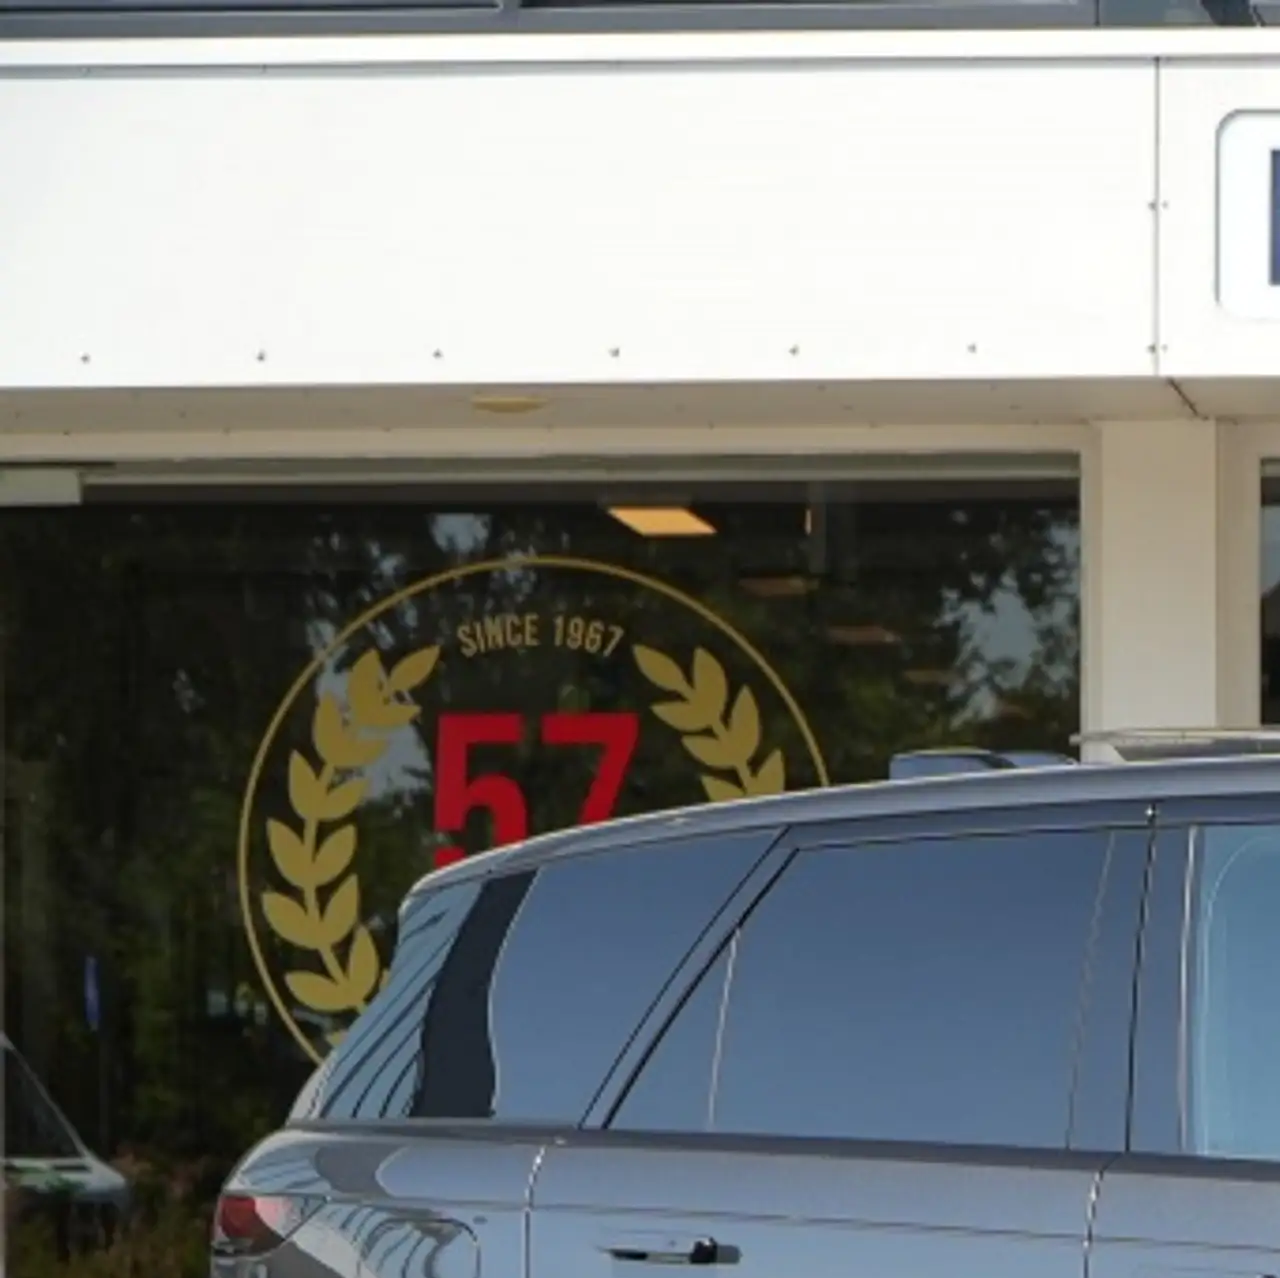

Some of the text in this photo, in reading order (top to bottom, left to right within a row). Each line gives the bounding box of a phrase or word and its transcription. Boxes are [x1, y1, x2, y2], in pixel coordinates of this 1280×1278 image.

[456, 612, 627, 659] SINCE 1967
[433, 712, 639, 867] 57
